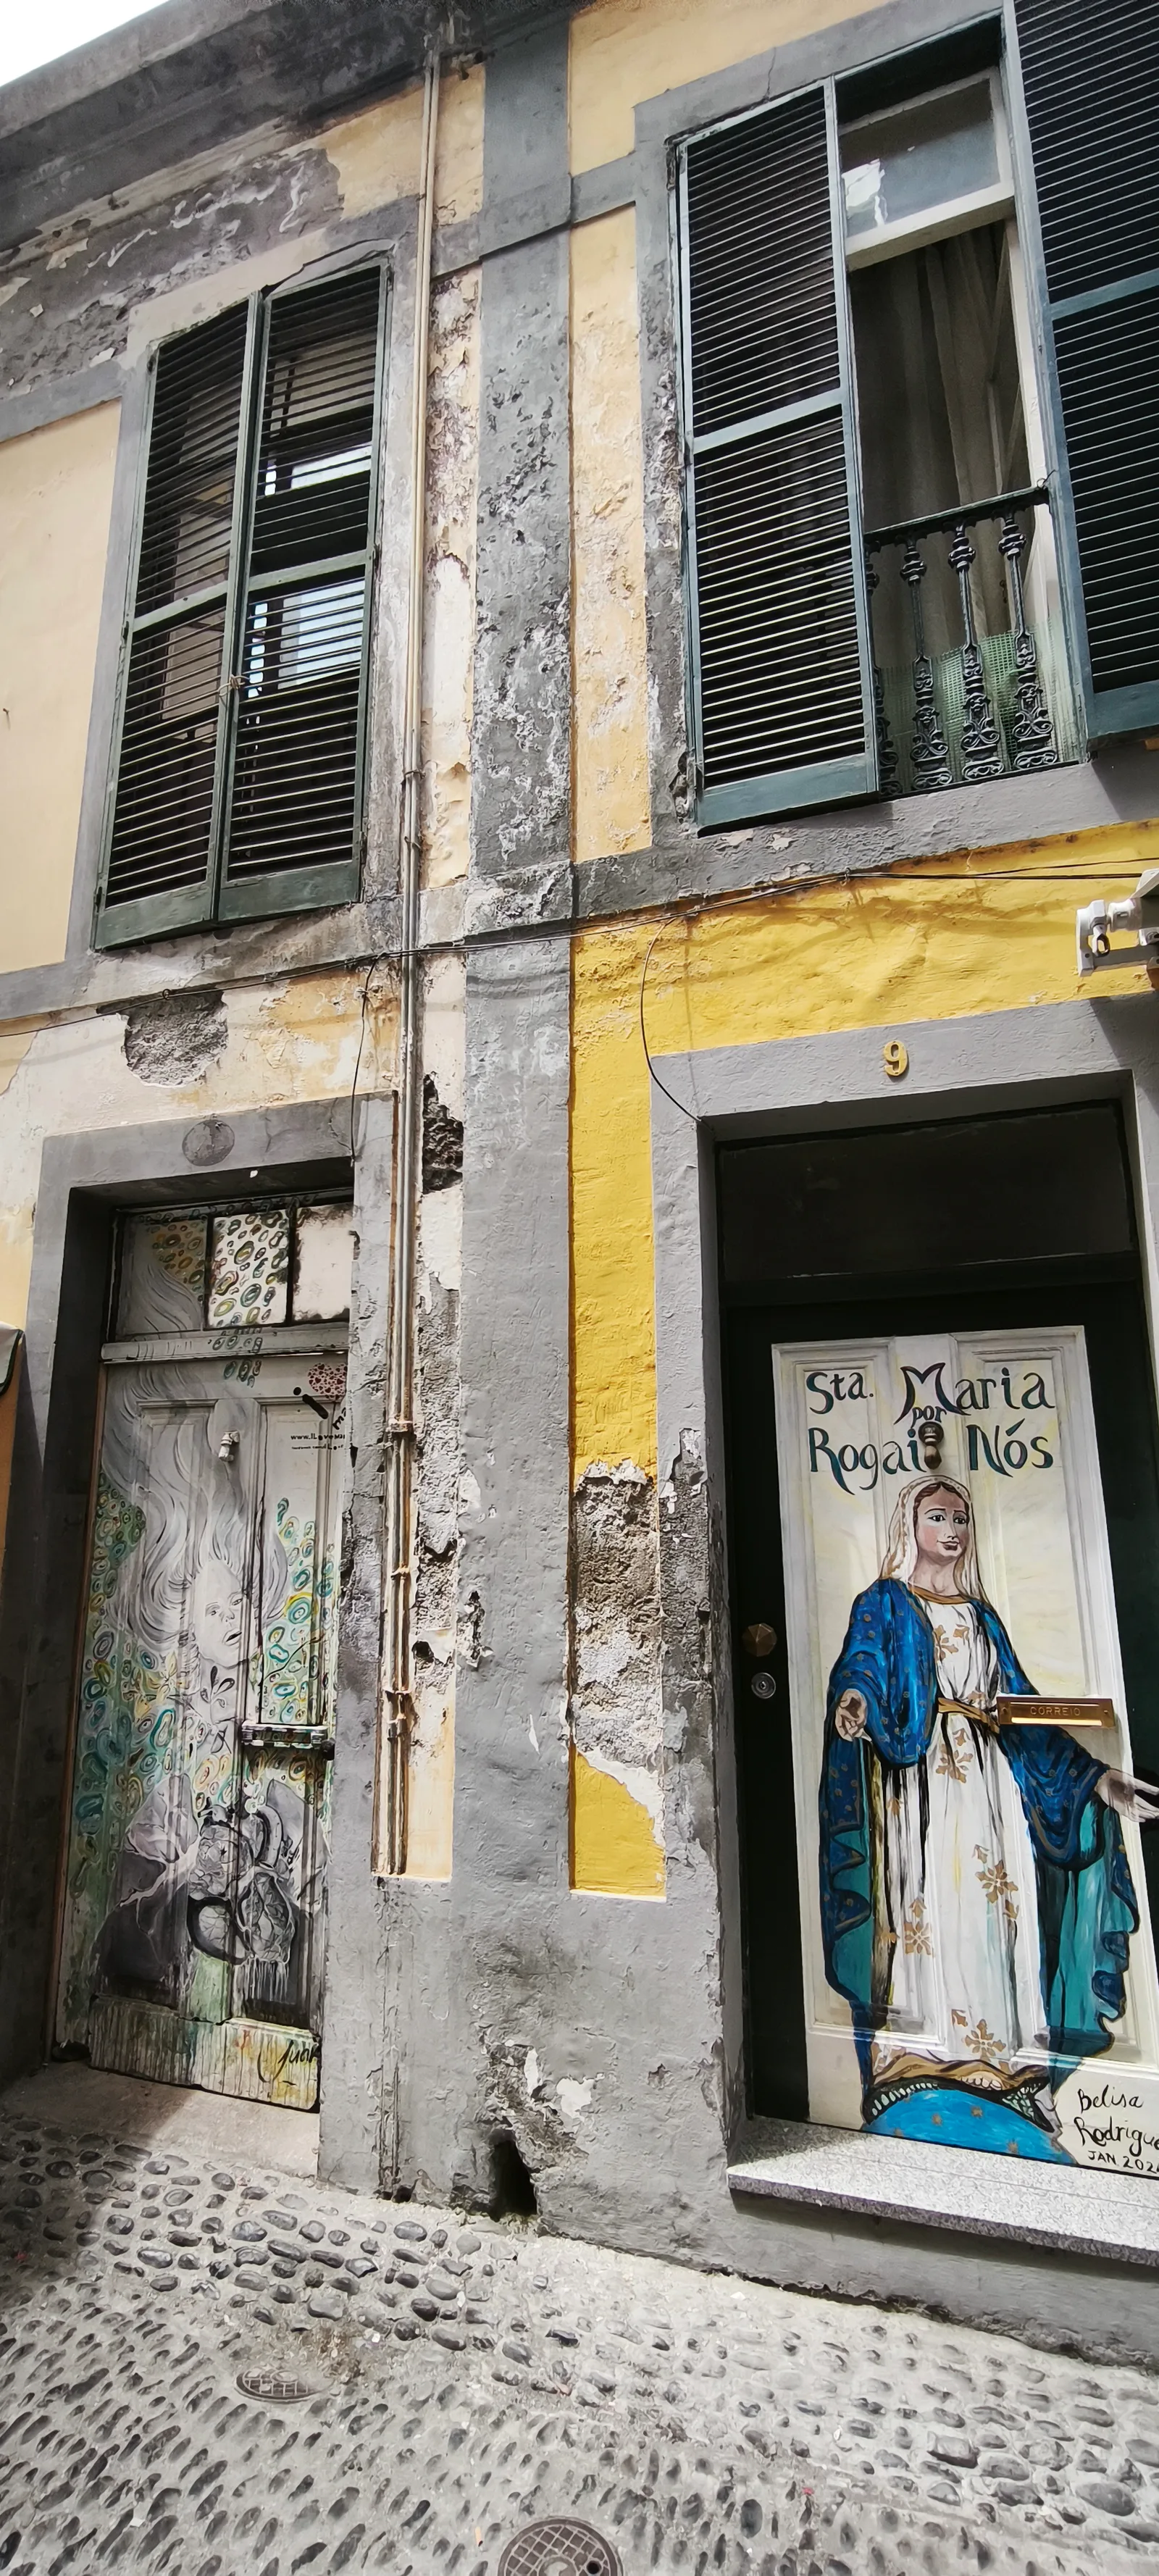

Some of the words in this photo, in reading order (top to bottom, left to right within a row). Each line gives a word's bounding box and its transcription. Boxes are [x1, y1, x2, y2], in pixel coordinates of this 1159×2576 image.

[883, 1040, 908, 1076] 9
[806, 1371, 874, 1415] Sta.
[894, 1362, 1055, 1425] Maria
[911, 1407, 947, 1429] por
[808, 1426, 927, 1495] Rogai
[966, 1418, 1055, 1478] Nós
[1029, 1706, 1081, 1717] CORREIO
[1077, 2084, 1145, 2113] Belisa
